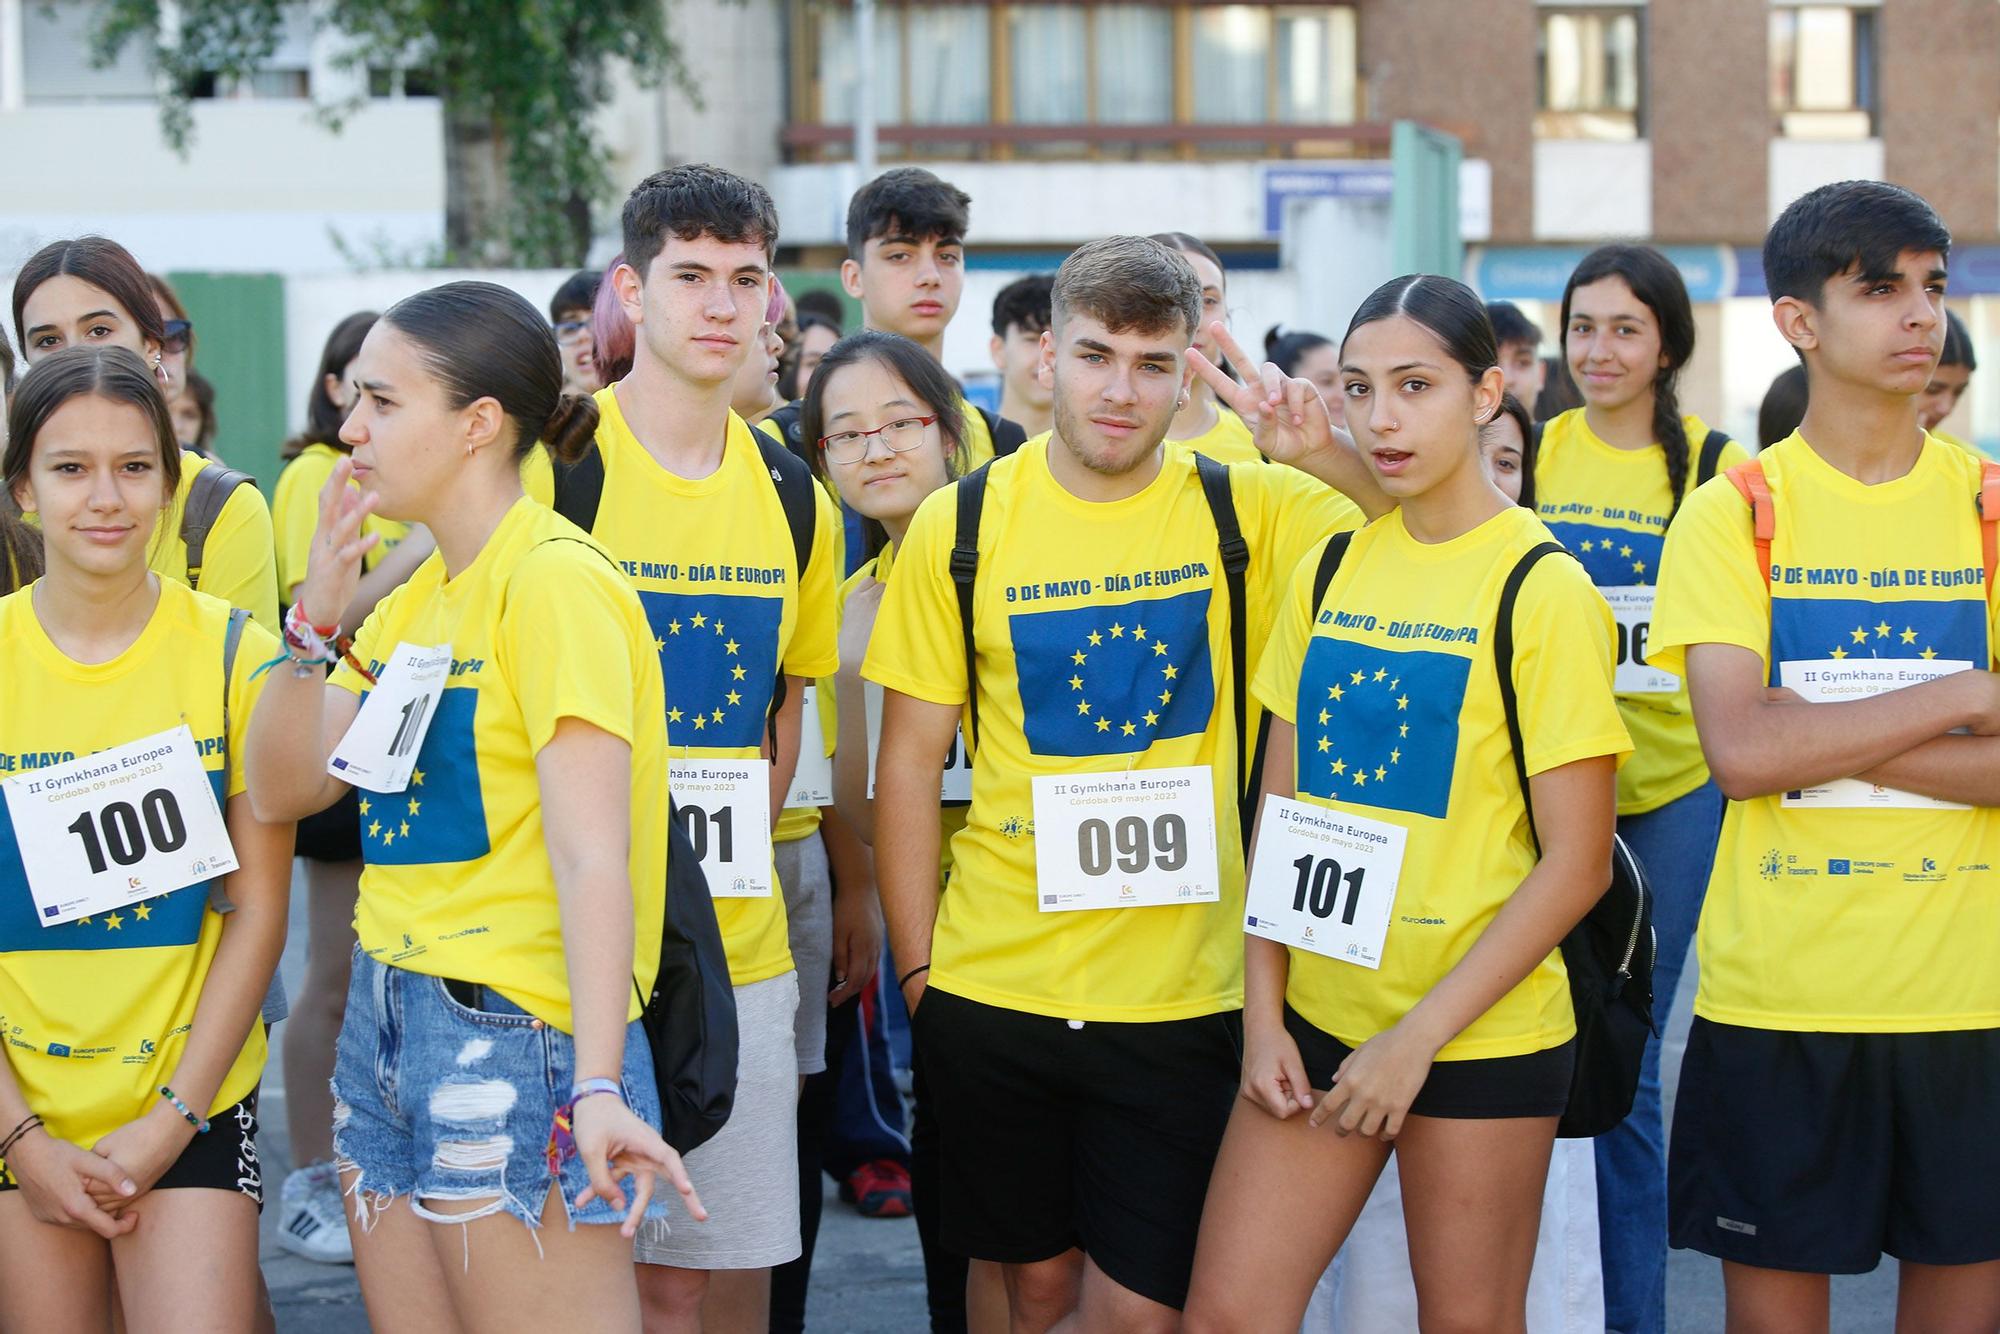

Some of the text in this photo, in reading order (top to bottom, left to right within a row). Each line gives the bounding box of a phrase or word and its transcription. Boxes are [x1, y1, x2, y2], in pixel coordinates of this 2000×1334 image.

[641, 562, 678, 580] MAYO
[688, 563, 716, 581] DÍA
[1006, 587, 1016, 602] 9
[1021, 584, 1041, 601] DE
[1045, 579, 1092, 598] MAYO
[1104, 573, 1131, 592] DÍA
[1134, 571, 1152, 588] DE
[1154, 562, 1210, 586] EUROPA
[1771, 565, 1781, 582] 9
[1785, 567, 1803, 584] DE
[1807, 568, 1858, 585] MAYO
[1870, 568, 1900, 587] DÍA
[1905, 569, 1927, 586] DE
[1334, 611, 1377, 631] MAYO
[1387, 620, 1412, 638] DÍA
[1804, 672, 1816, 682] II
[1821, 670, 1894, 683] Gymkhana
[28, 744, 174, 794] II Gymkhana Europea
[92, 779, 107, 791] 09
[109, 773, 138, 787] mayo
[139, 762, 164, 777] 2023
[702, 769, 749, 781] Europea
[674, 782, 736, 792] 09 mayo 2023
[1054, 778, 1191, 796] II Gymkhana Europea
[1111, 795, 1123, 804] 09
[1126, 794, 1151, 804] mayo
[1154, 792, 1177, 801] 2023
[68, 788, 188, 874] 100
[1279, 808, 1388, 845] II Gymkhana Europea
[1077, 813, 1188, 877] 099
[1320, 833, 1331, 843] 09
[1332, 837, 1353, 849] mayo
[1355, 841, 1375, 854] 2023
[1293, 853, 1366, 926] 101
[1400, 915, 1446, 926] eurodesk
